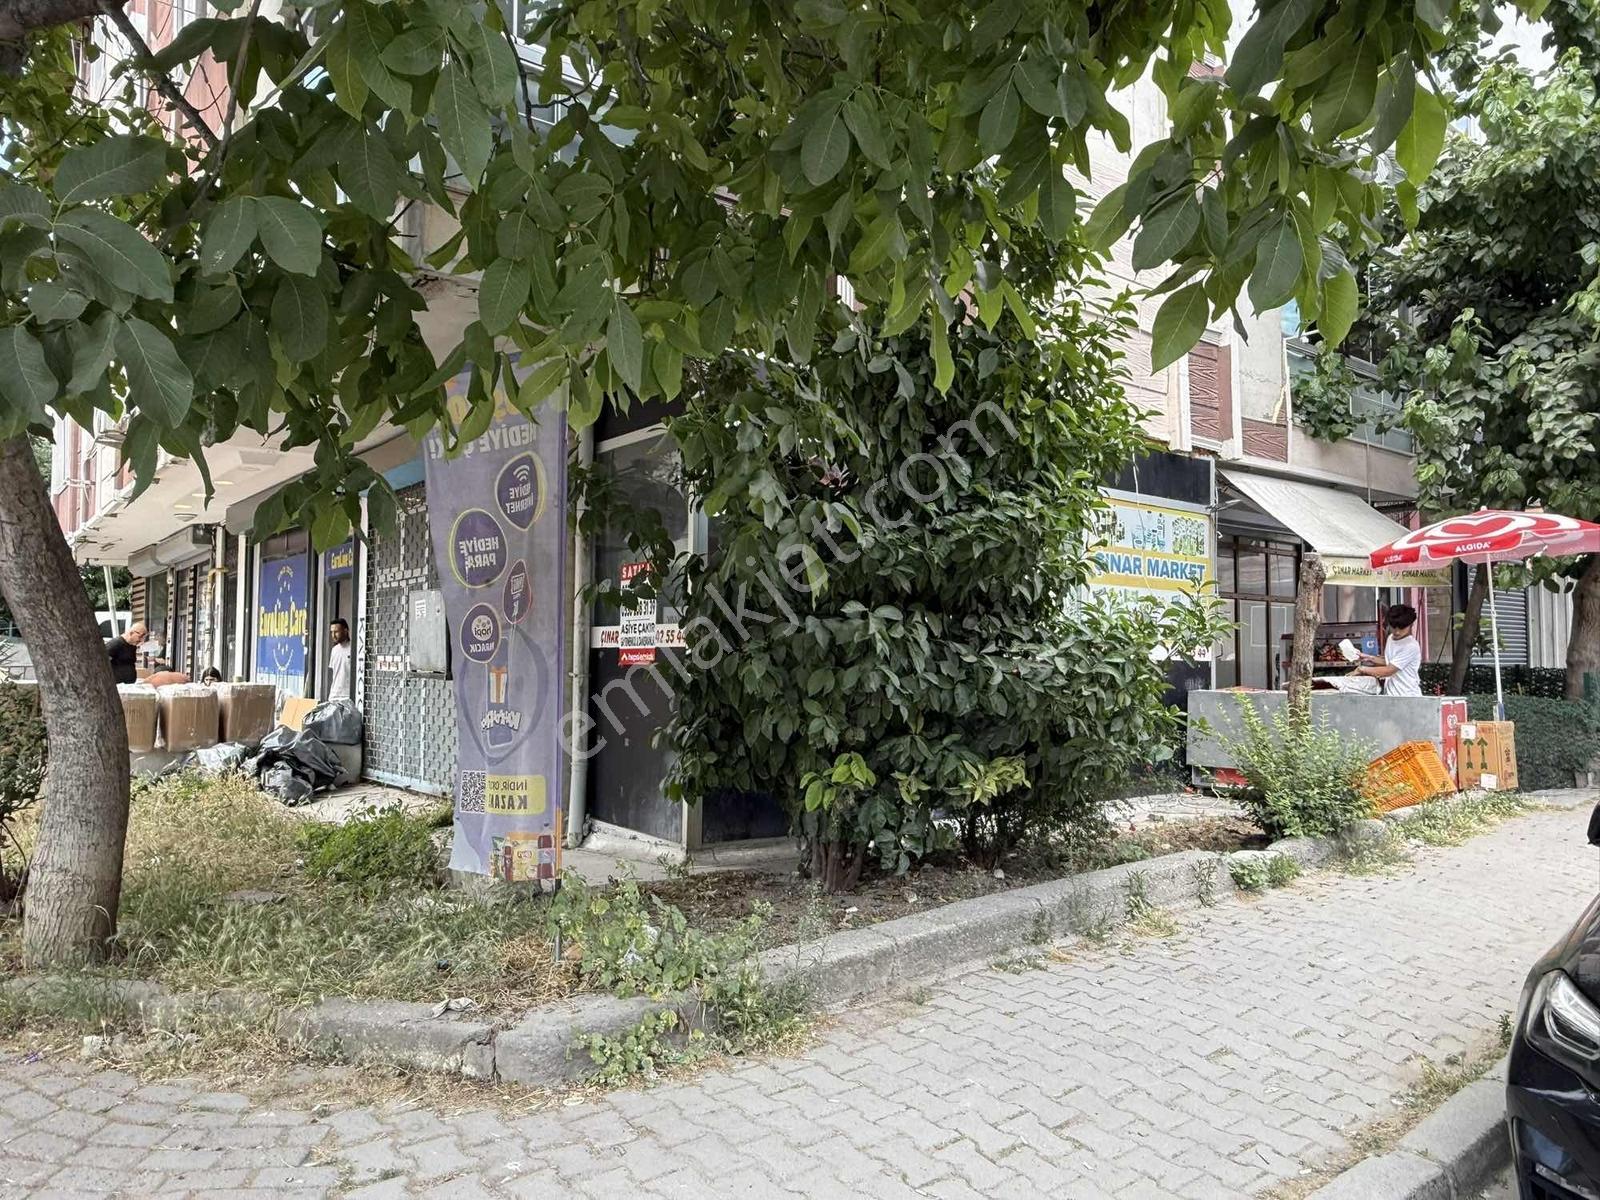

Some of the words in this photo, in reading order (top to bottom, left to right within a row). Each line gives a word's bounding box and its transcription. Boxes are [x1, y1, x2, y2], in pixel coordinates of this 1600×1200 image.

[1455, 541, 1491, 554] ALGIDA
[1146, 557, 1206, 582] MARKET
[600, 630, 620, 647] ÇINAR
